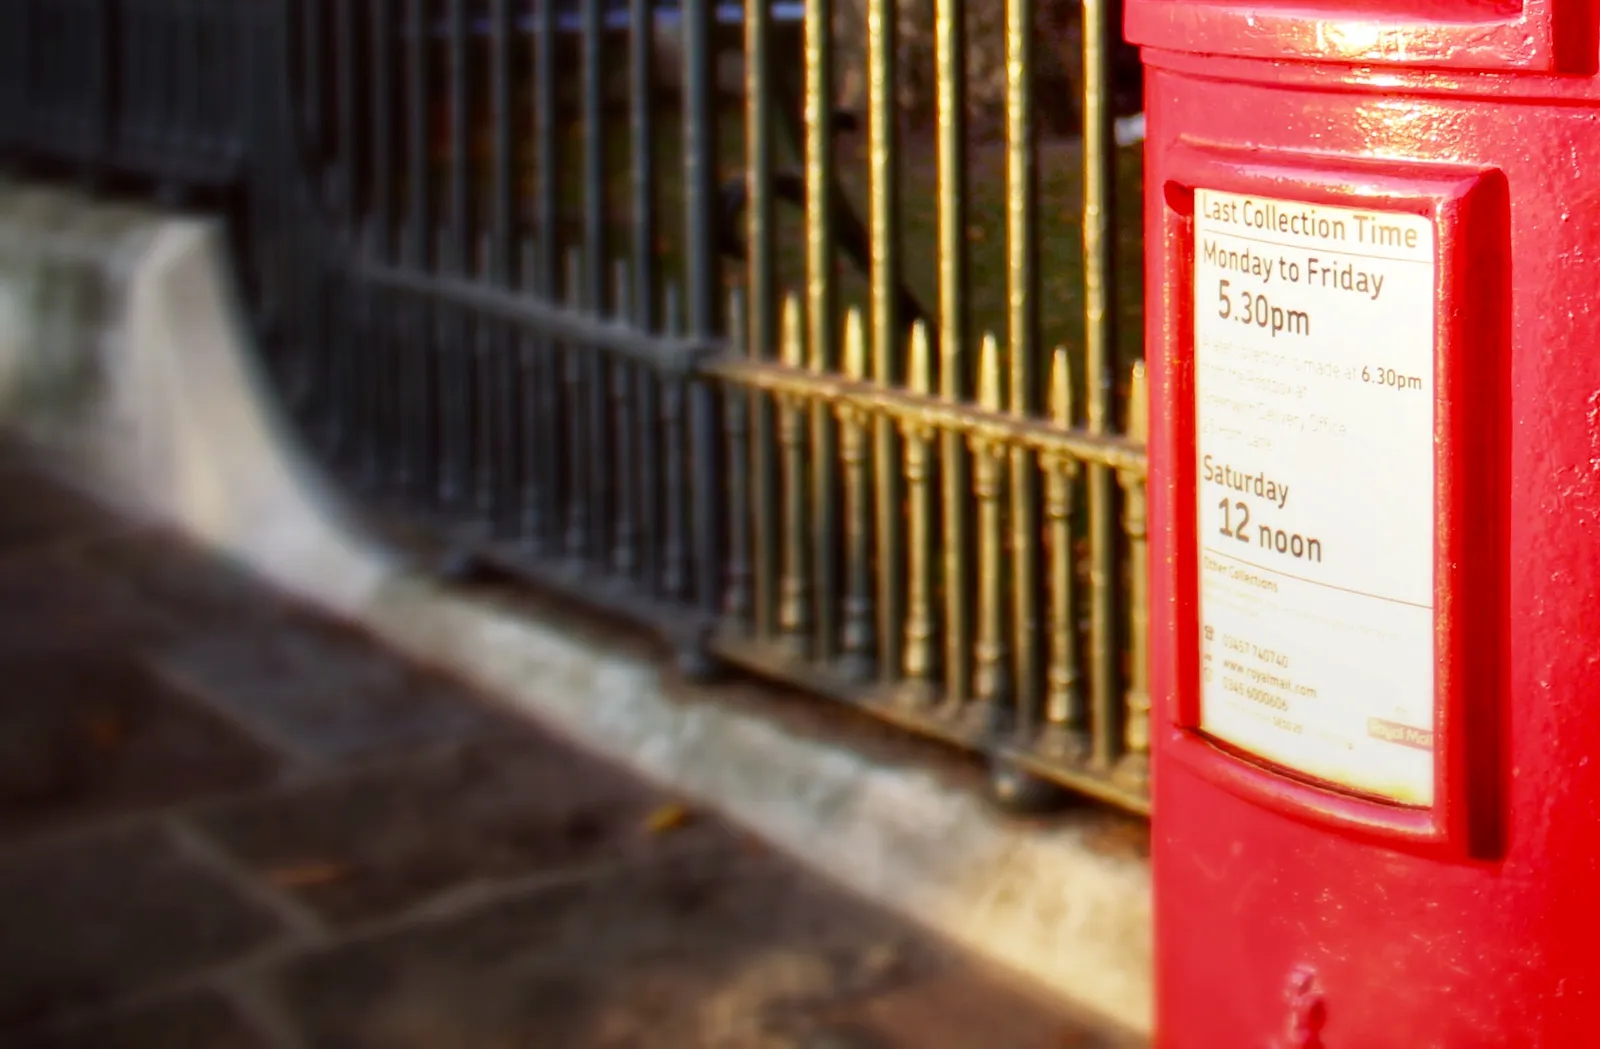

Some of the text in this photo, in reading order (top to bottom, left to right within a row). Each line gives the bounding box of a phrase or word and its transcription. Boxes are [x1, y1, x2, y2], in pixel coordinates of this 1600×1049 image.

[1203, 192, 1418, 249] Last Collection Time
[1203, 239, 1384, 301] Monday to Friday
[1218, 280, 1310, 338] 5.30pm
[1361, 365, 1423, 391] 6.30pm
[1203, 454, 1289, 509] Saturday
[1218, 497, 1322, 564] 12 noon
